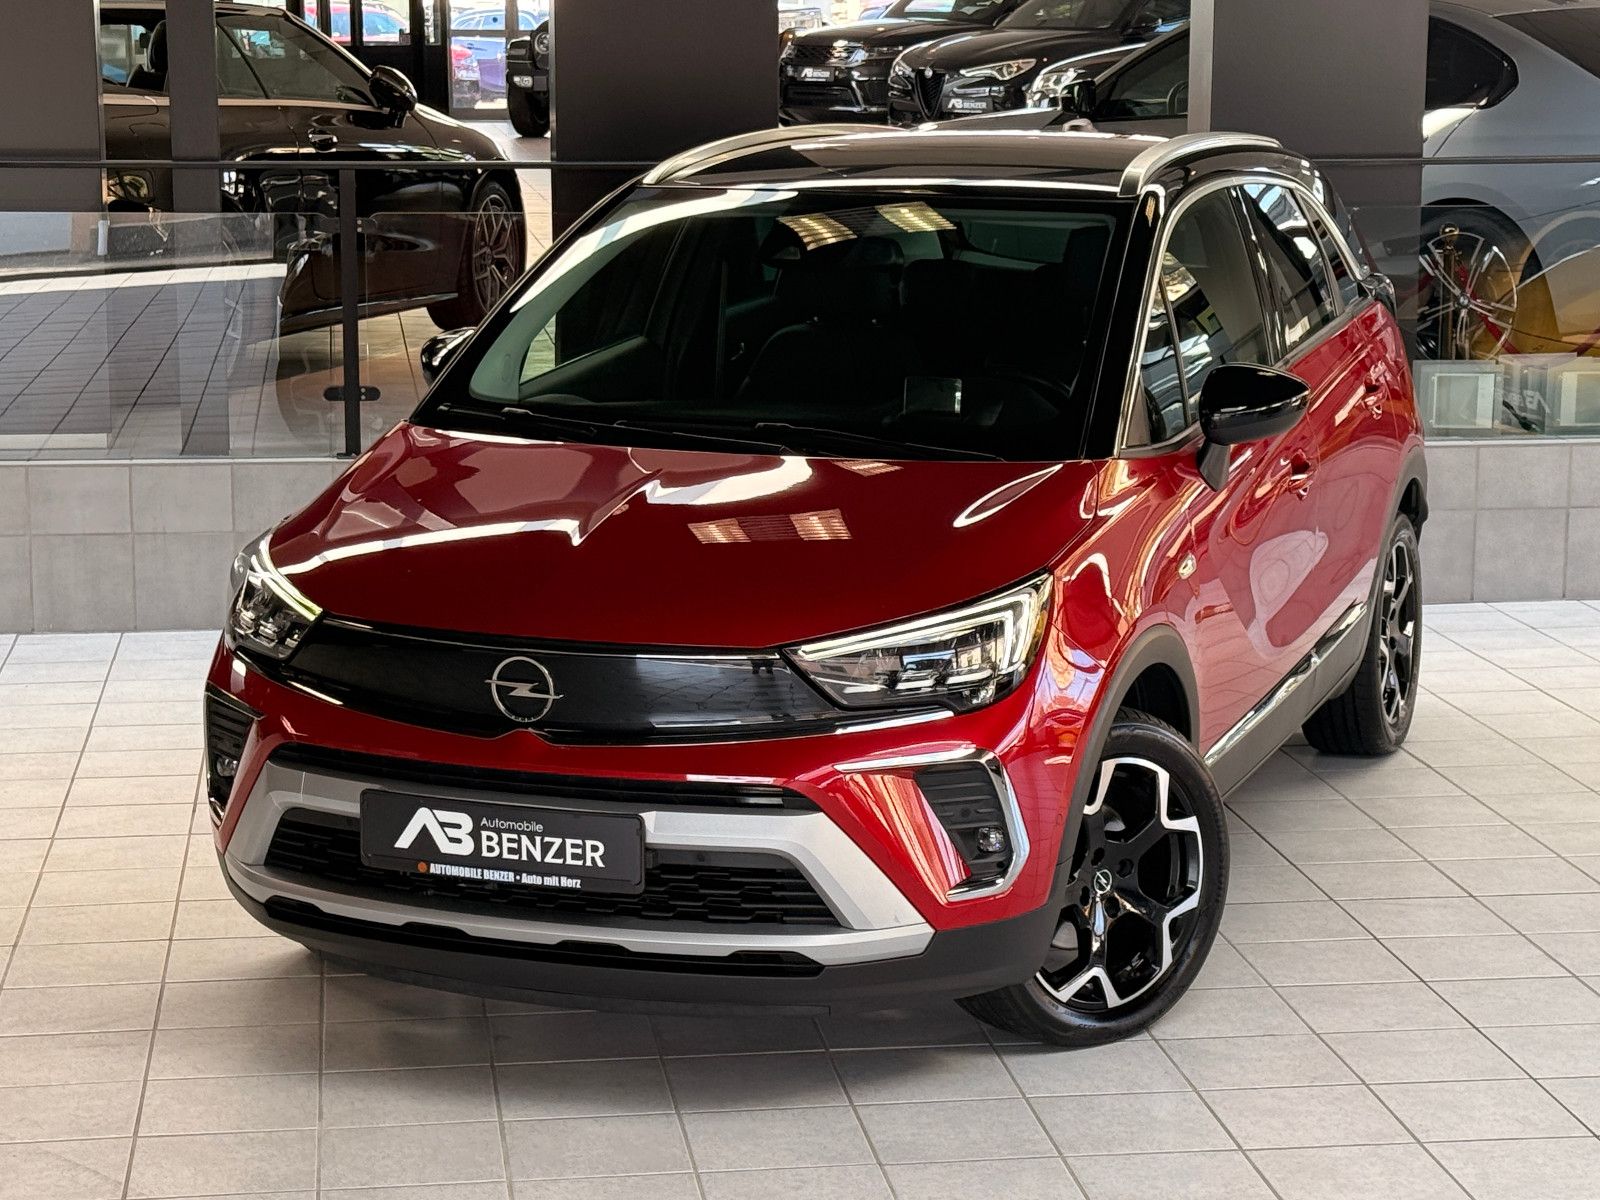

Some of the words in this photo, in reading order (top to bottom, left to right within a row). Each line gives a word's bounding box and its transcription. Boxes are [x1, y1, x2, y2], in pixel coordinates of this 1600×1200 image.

[947, 98, 963, 109] AB
[394, 806, 475, 856] AB
[480, 817, 544, 832] Automobile
[480, 830, 606, 868] BENZER
[429, 863, 482, 879] AUTOMOBILE
[483, 868, 515, 883] BENZER
[521, 872, 543, 885] Auto
[543, 875, 560, 887] mit
